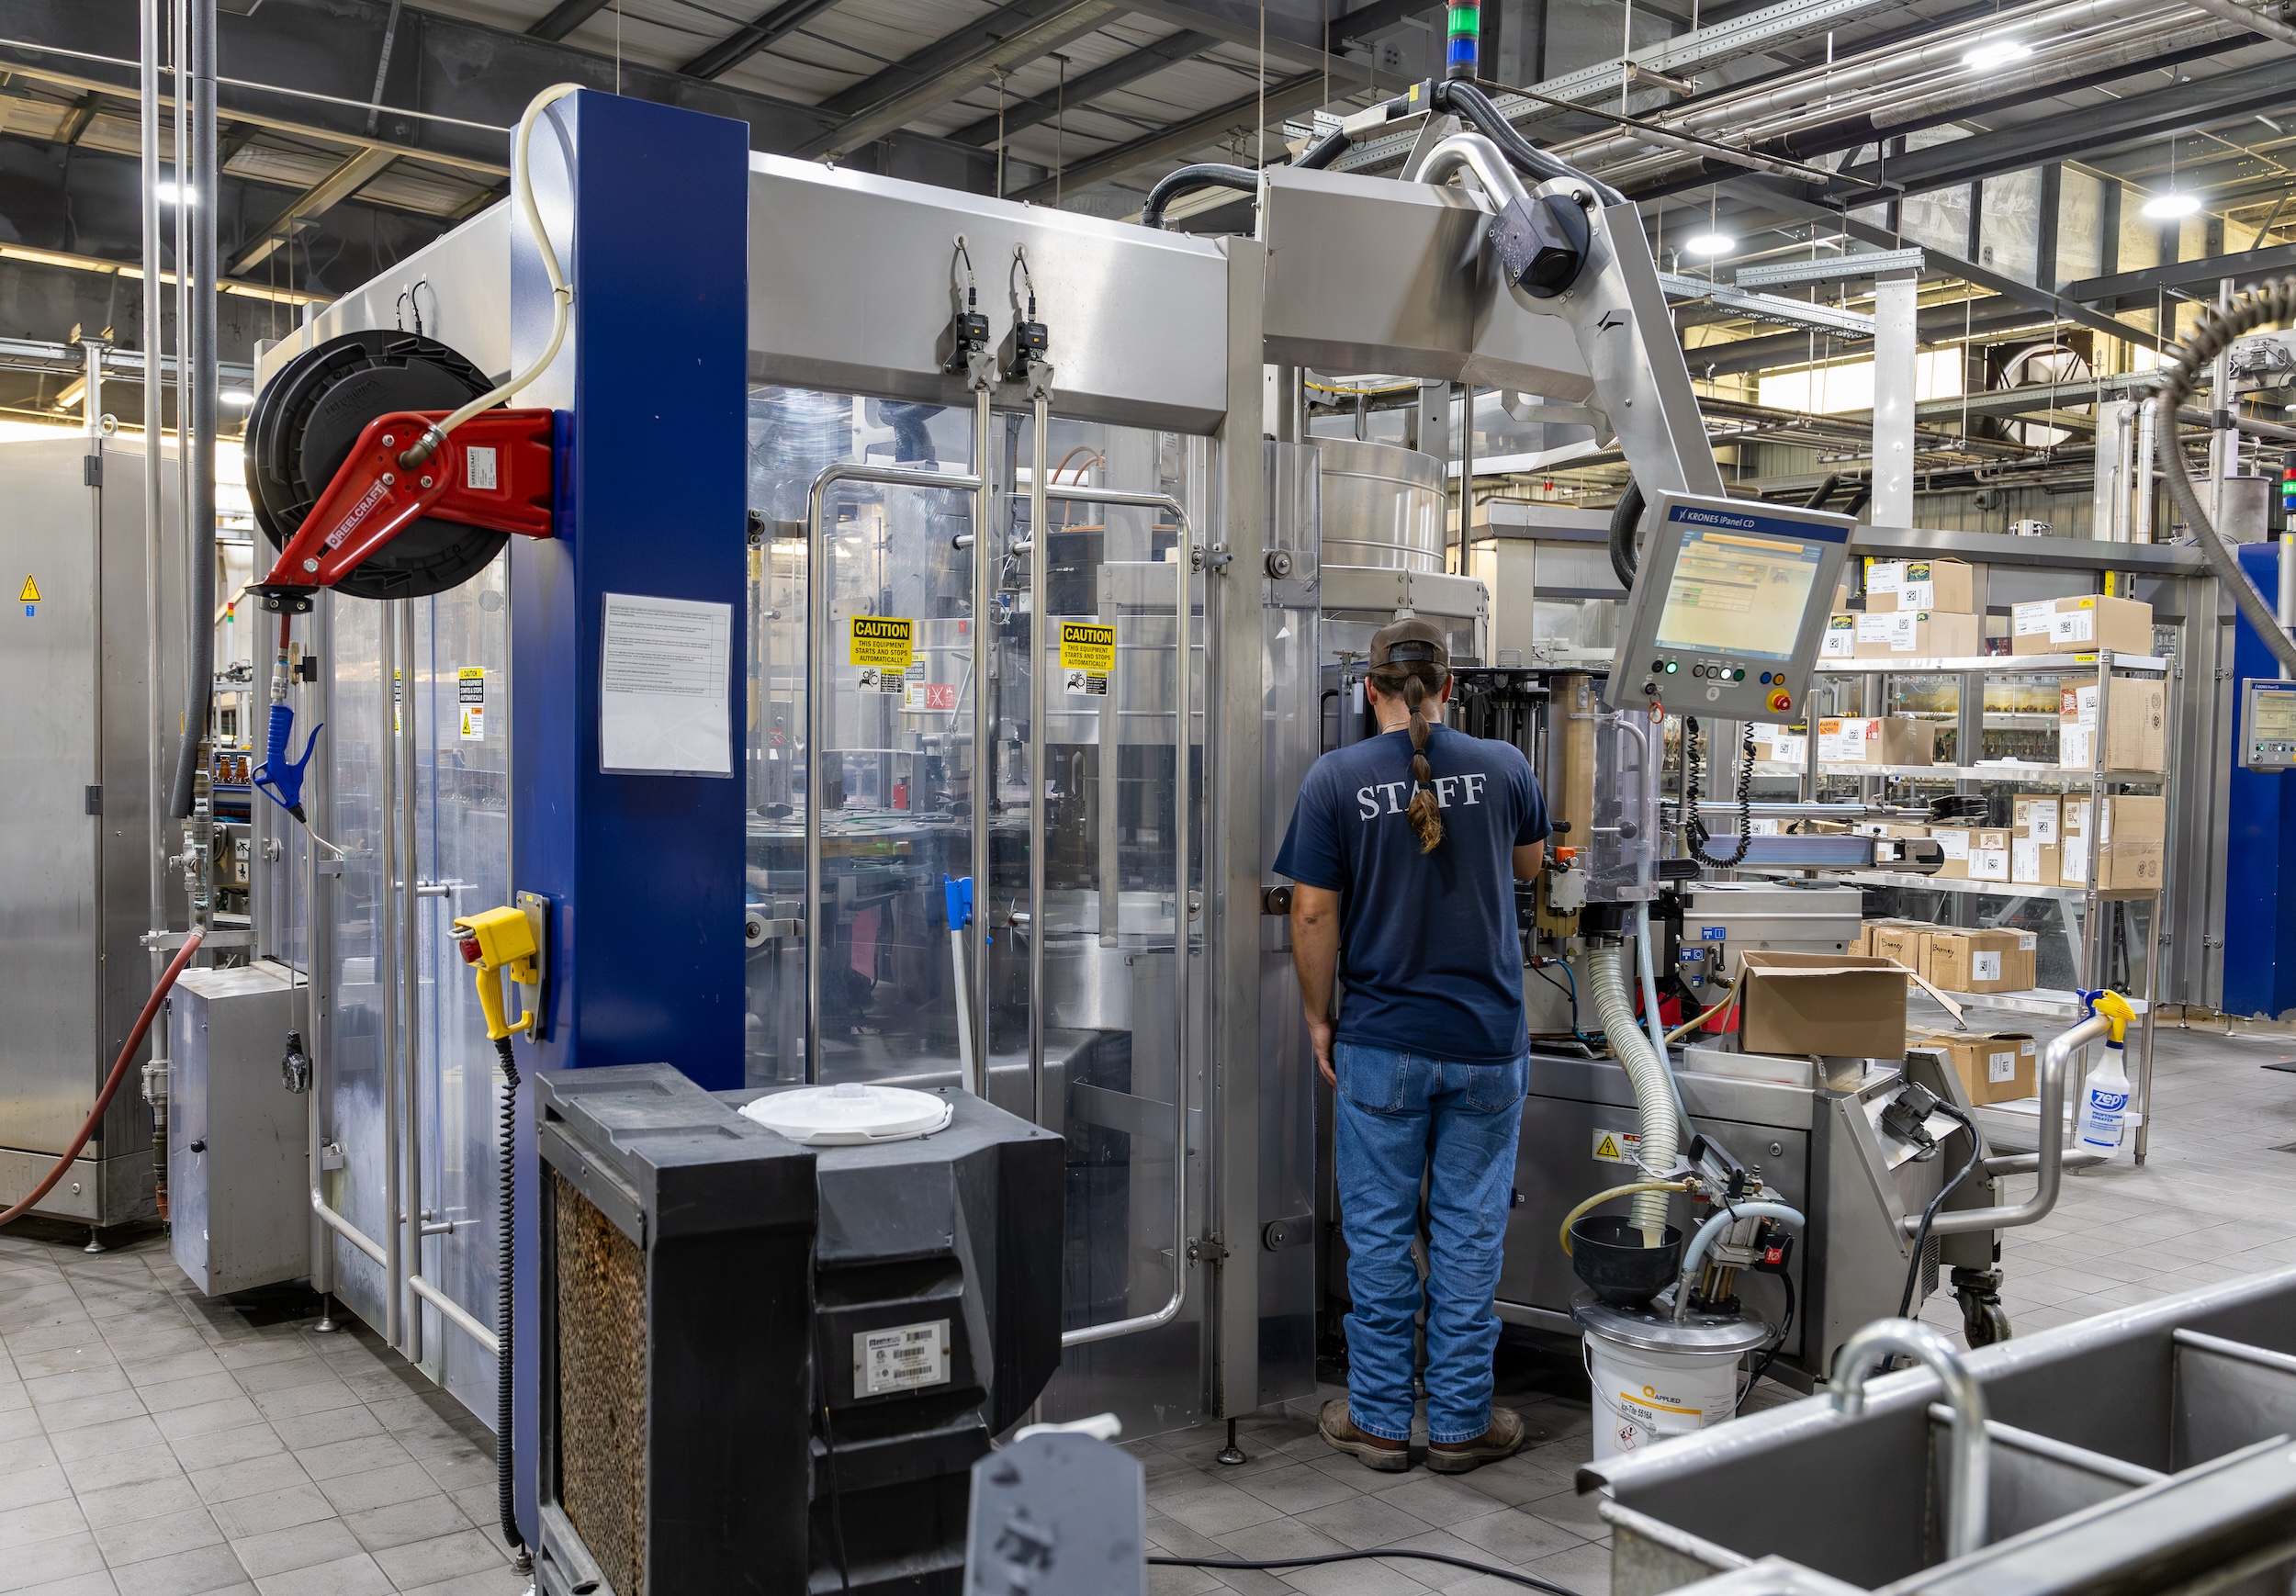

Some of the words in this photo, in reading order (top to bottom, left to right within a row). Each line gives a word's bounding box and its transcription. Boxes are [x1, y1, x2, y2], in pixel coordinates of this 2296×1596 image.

[334, 484, 384, 540] REELCRAFT
[1687, 511, 1720, 523] KRONES
[1719, 515, 1743, 526] iPanel
[1743, 519, 1755, 528] CD
[856, 622, 908, 637] CAUTION
[1065, 627, 1111, 644] CAUTION
[1067, 658, 1107, 667] AUTOMATICALLY
[1881, 938, 1903, 953] Barney
[1932, 943, 1955, 959] Barney
[2092, 1115, 2113, 1123] SPRAYER
[1654, 1394, 1681, 1404] APPLIED
[1621, 1401, 1638, 1416] Ice-Tite
